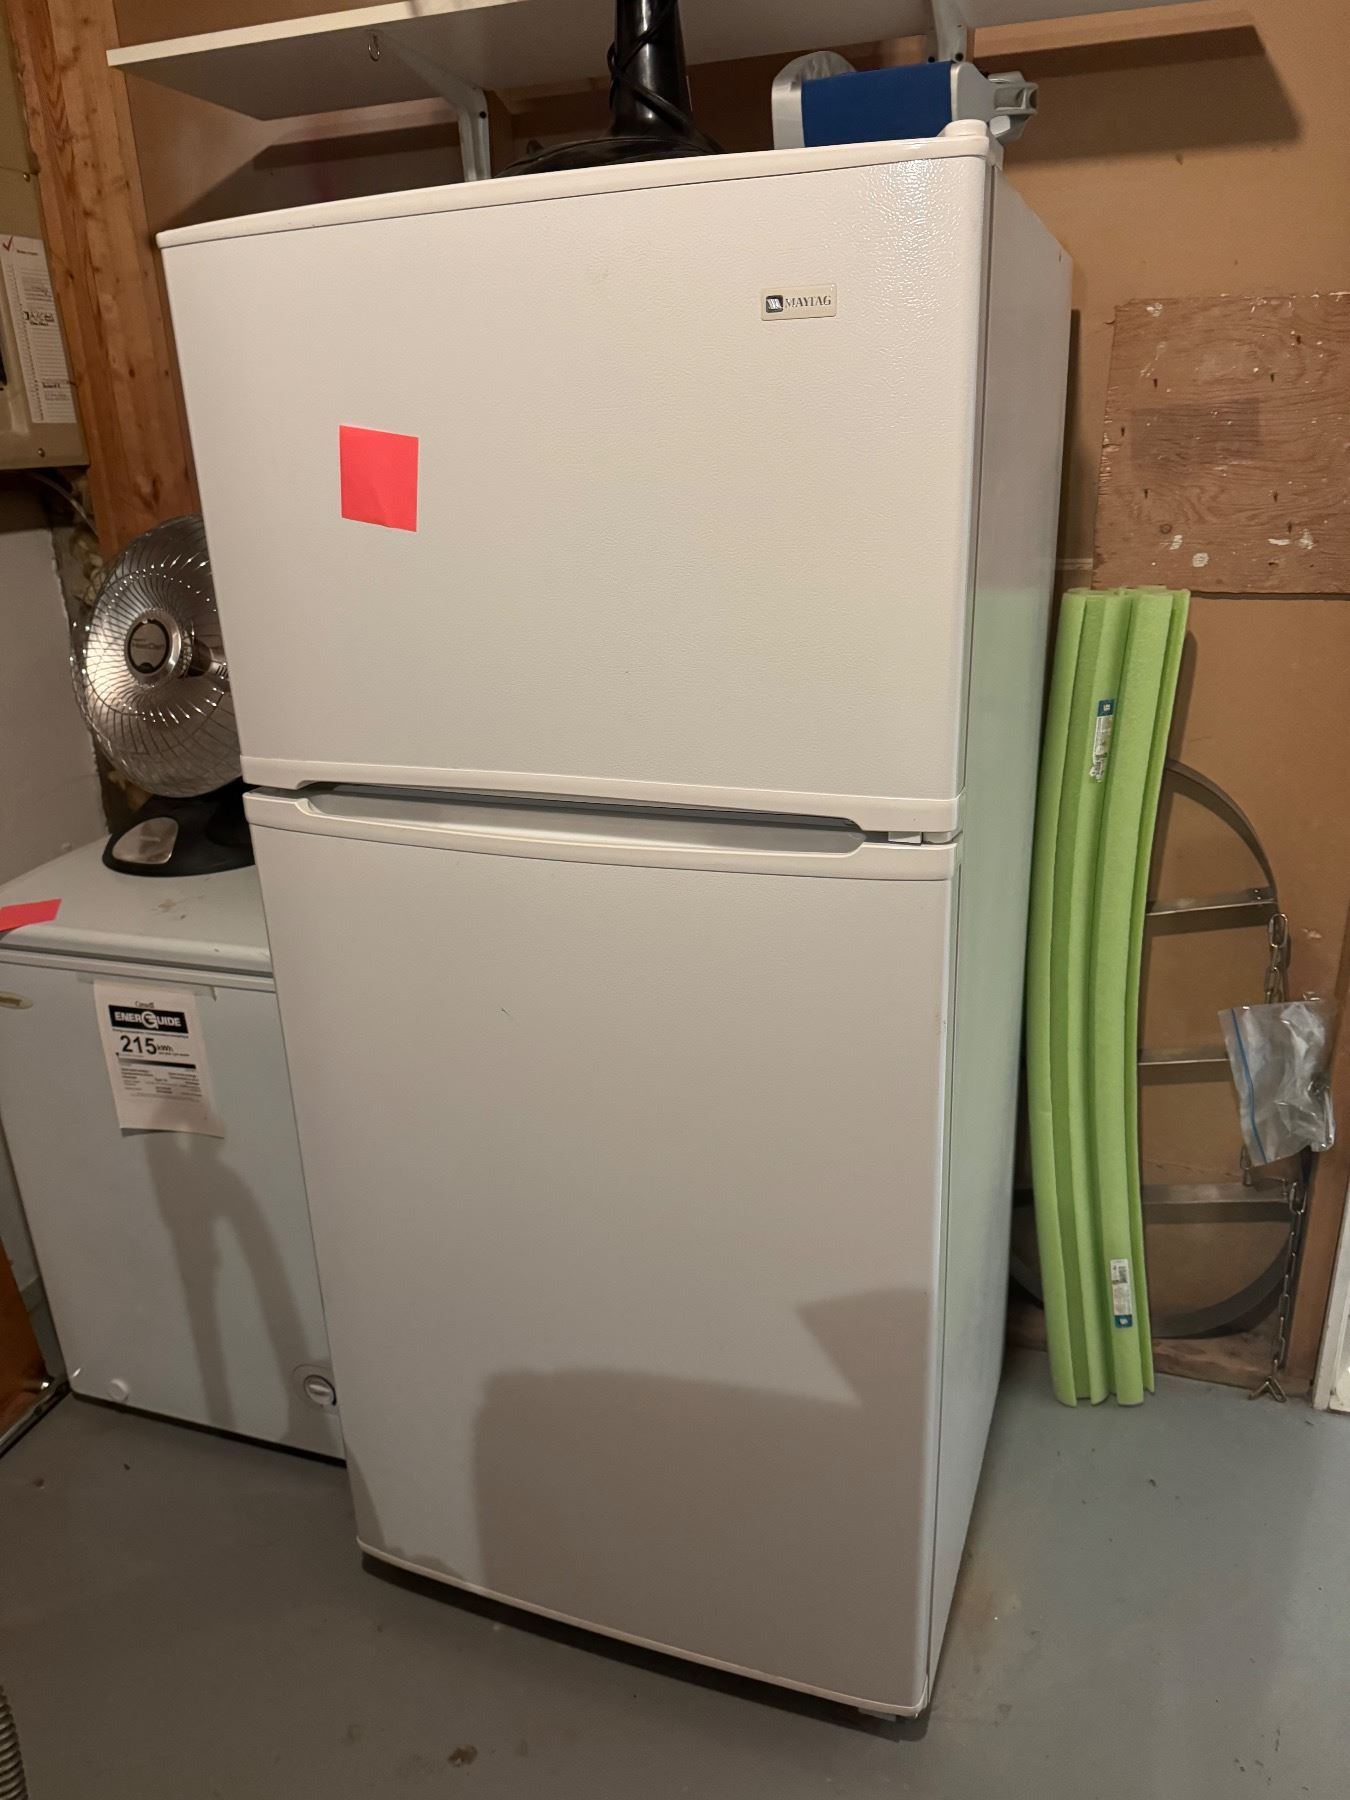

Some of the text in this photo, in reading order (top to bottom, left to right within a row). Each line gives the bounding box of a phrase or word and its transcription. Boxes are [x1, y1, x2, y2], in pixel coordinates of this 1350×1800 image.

[785, 295, 831, 308] MAYTAG
[114, 1011, 182, 1029] ENERGUIDE
[120, 1035, 157, 1055] 215
